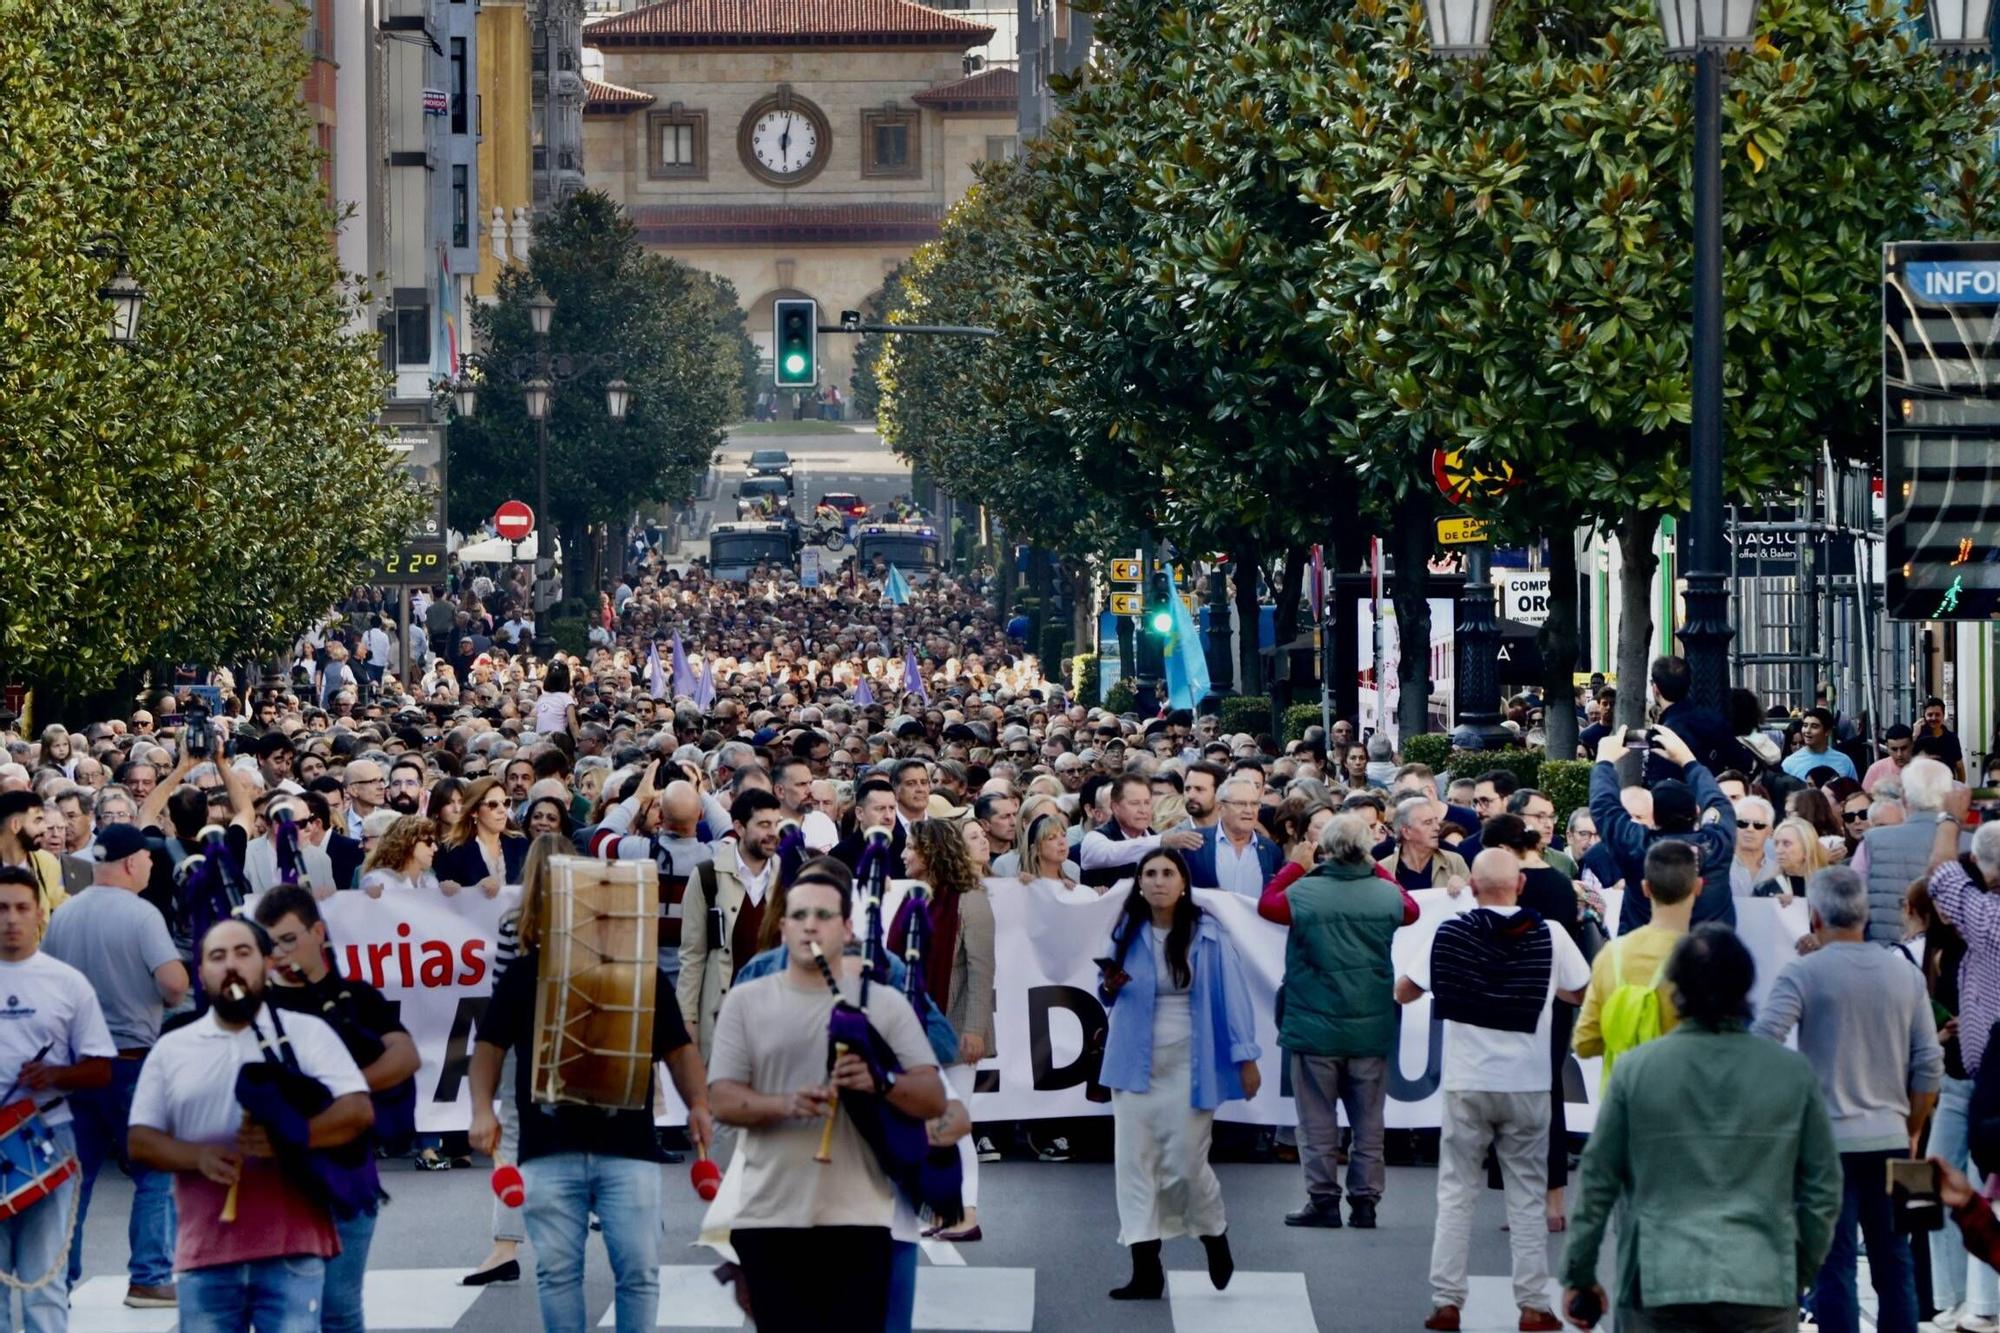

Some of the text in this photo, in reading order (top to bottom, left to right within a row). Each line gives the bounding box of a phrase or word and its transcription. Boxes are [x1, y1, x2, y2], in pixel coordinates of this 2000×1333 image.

[1926, 270, 2000, 295] INFO
[1444, 531, 1459, 540] DE
[1731, 548, 1758, 559] offee
[1770, 547, 1797, 560] Bakery
[1511, 581, 1550, 592] COMP
